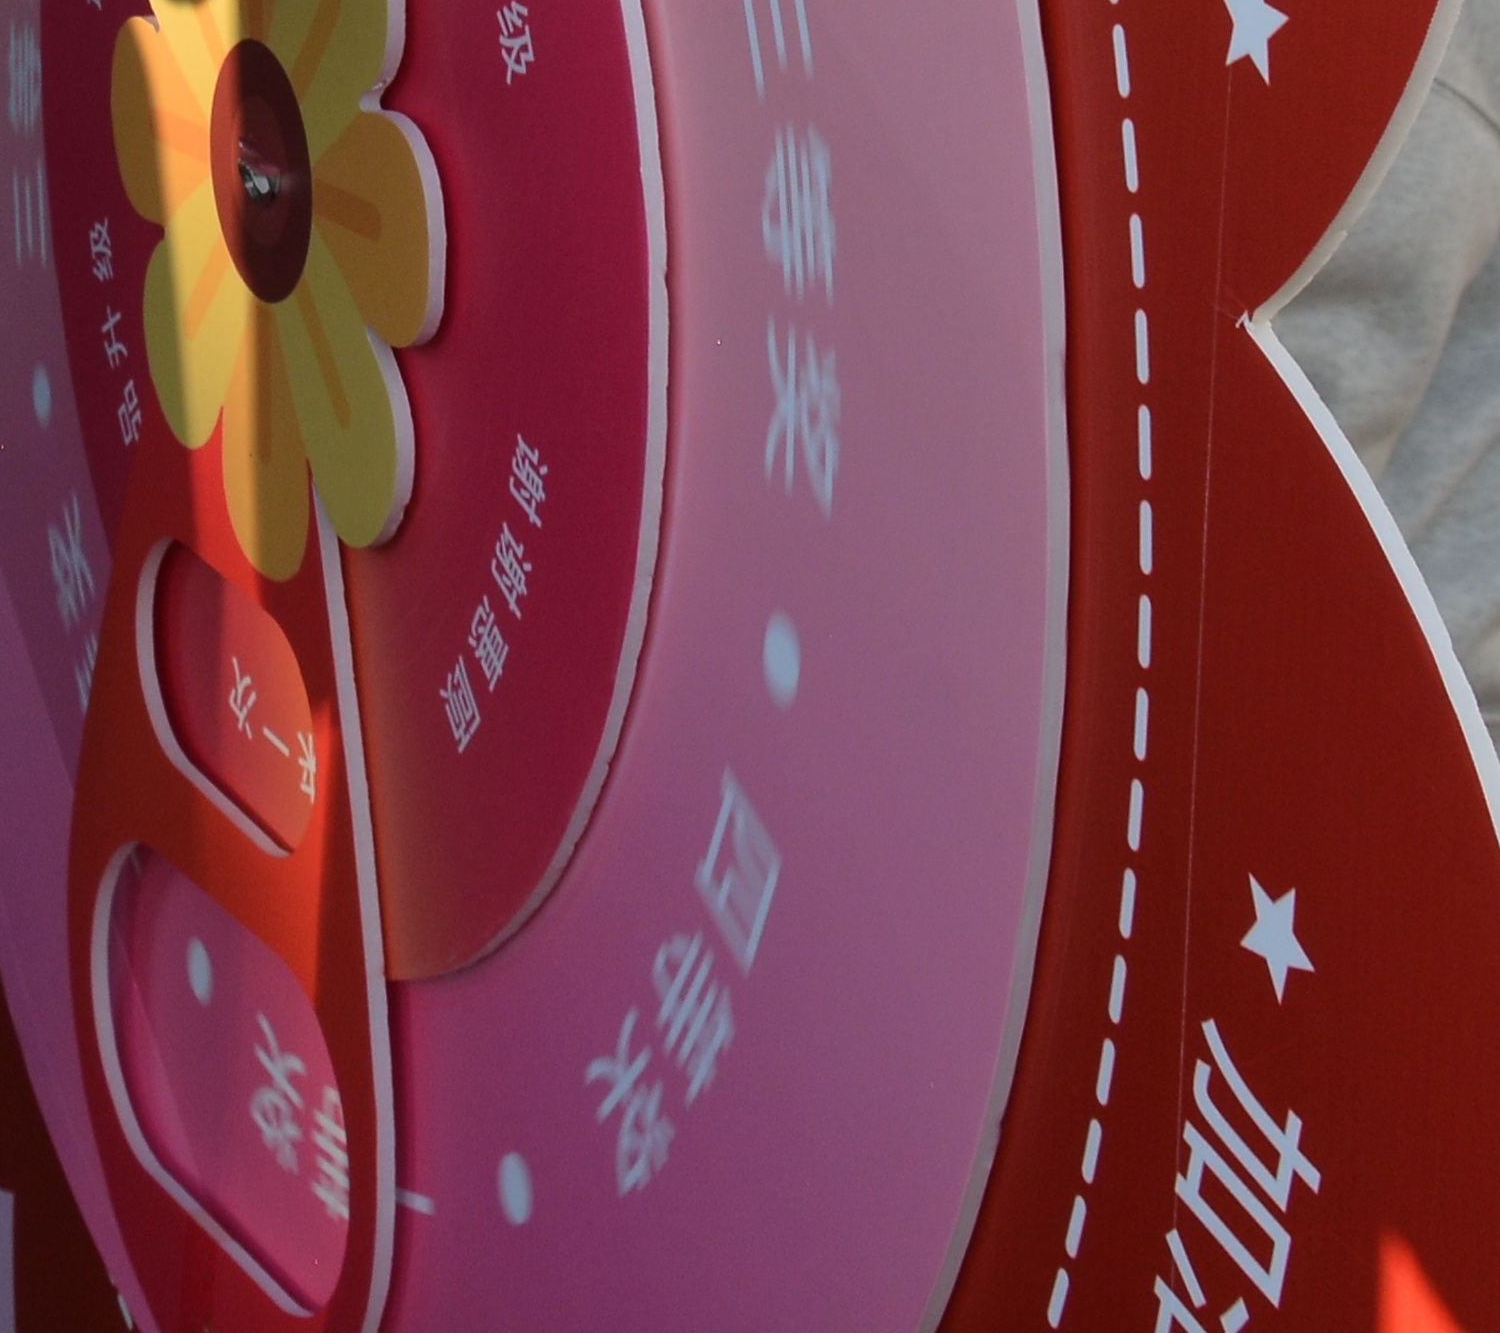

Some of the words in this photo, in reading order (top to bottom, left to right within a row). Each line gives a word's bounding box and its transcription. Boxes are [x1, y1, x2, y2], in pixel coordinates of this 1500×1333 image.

[439, 433, 549, 754] 谢谢惠顾
[584, 763, 783, 1197] 四等奖
